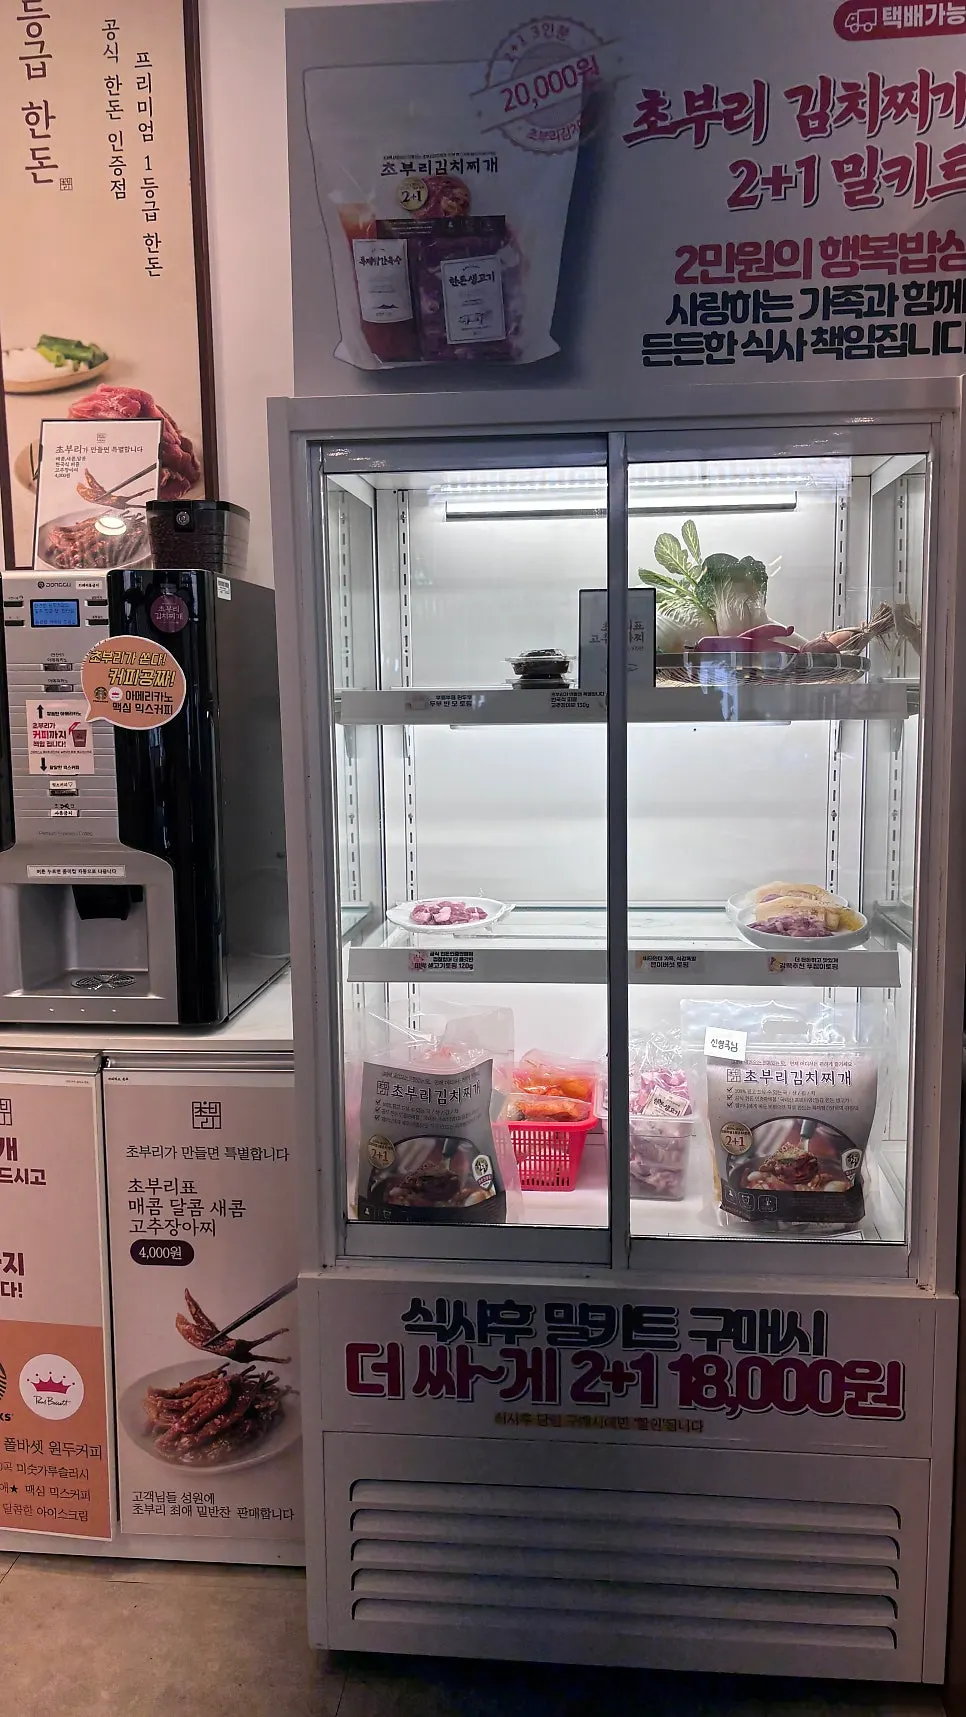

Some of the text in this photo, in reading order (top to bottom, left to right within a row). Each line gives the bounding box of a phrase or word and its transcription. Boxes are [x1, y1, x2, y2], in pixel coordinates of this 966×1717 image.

[883, 2, 966, 29] 택배가능
[102, 20, 127, 200] 공식 한돈 인증점
[623, 79, 768, 147] 초부리
[22, 100, 58, 184] 한돈
[135, 52, 163, 277] 프리미엄 1등급 한돈
[380, 155, 499, 178] 초부리김치찌개
[727, 155, 819, 210] 2+1
[401, 190, 423, 204] 2+1
[674, 238, 813, 285] 2만원의
[665, 279, 966, 326] 사랑하는 가족과 함께
[642, 331, 736, 367] 든든한
[741, 328, 807, 363] 식사
[55, 444, 143, 455] 초부리가 만들면 특별합니다
[89, 650, 167, 666] 초부리가 쏜다!
[109, 668, 176, 687] 커피공짜!
[126, 690, 173, 703] 아메리카노
[112, 703, 173, 716] 맥심 믹스커피
[32, 730, 67, 740] 커피까지
[743, 1070, 852, 1086] 초부리김치찌개
[391, 1080, 481, 1105] 초부리김치찌개
[725, 1136, 744, 1147] 2+1
[126, 1145, 289, 1162] 초부리가 만들면 특별합니다
[371, 1153, 388, 1163] 2+1
[128, 1177, 198, 1195] 초부리표
[129, 1197, 246, 1218] 매콤 달콤 새콤
[129, 1217, 216, 1237] 고추장아찌
[139, 1246, 182, 1260] 4,000원
[402, 1298, 827, 1357] 식사후 밀키트 구매시
[346, 1342, 403, 1400] 더
[571, 1349, 657, 1407] 2+1
[668, 1353, 904, 1420] 18,000원
[4, 1437, 102, 1460] 폴바셋 원두커피
[17, 1463, 89, 1480] 미숫가루슬러시
[25, 1485, 45, 1497] 맥심
[50, 1487, 91, 1501] 믹스커피
[132, 1491, 215, 1505] 고객님들 성원에
[37, 1506, 88, 1522] 아이스크림
[132, 1503, 166, 1517] 초부리
[198, 1506, 230, 1518] 밑반찬
[237, 1507, 295, 1521] 판매합니다
